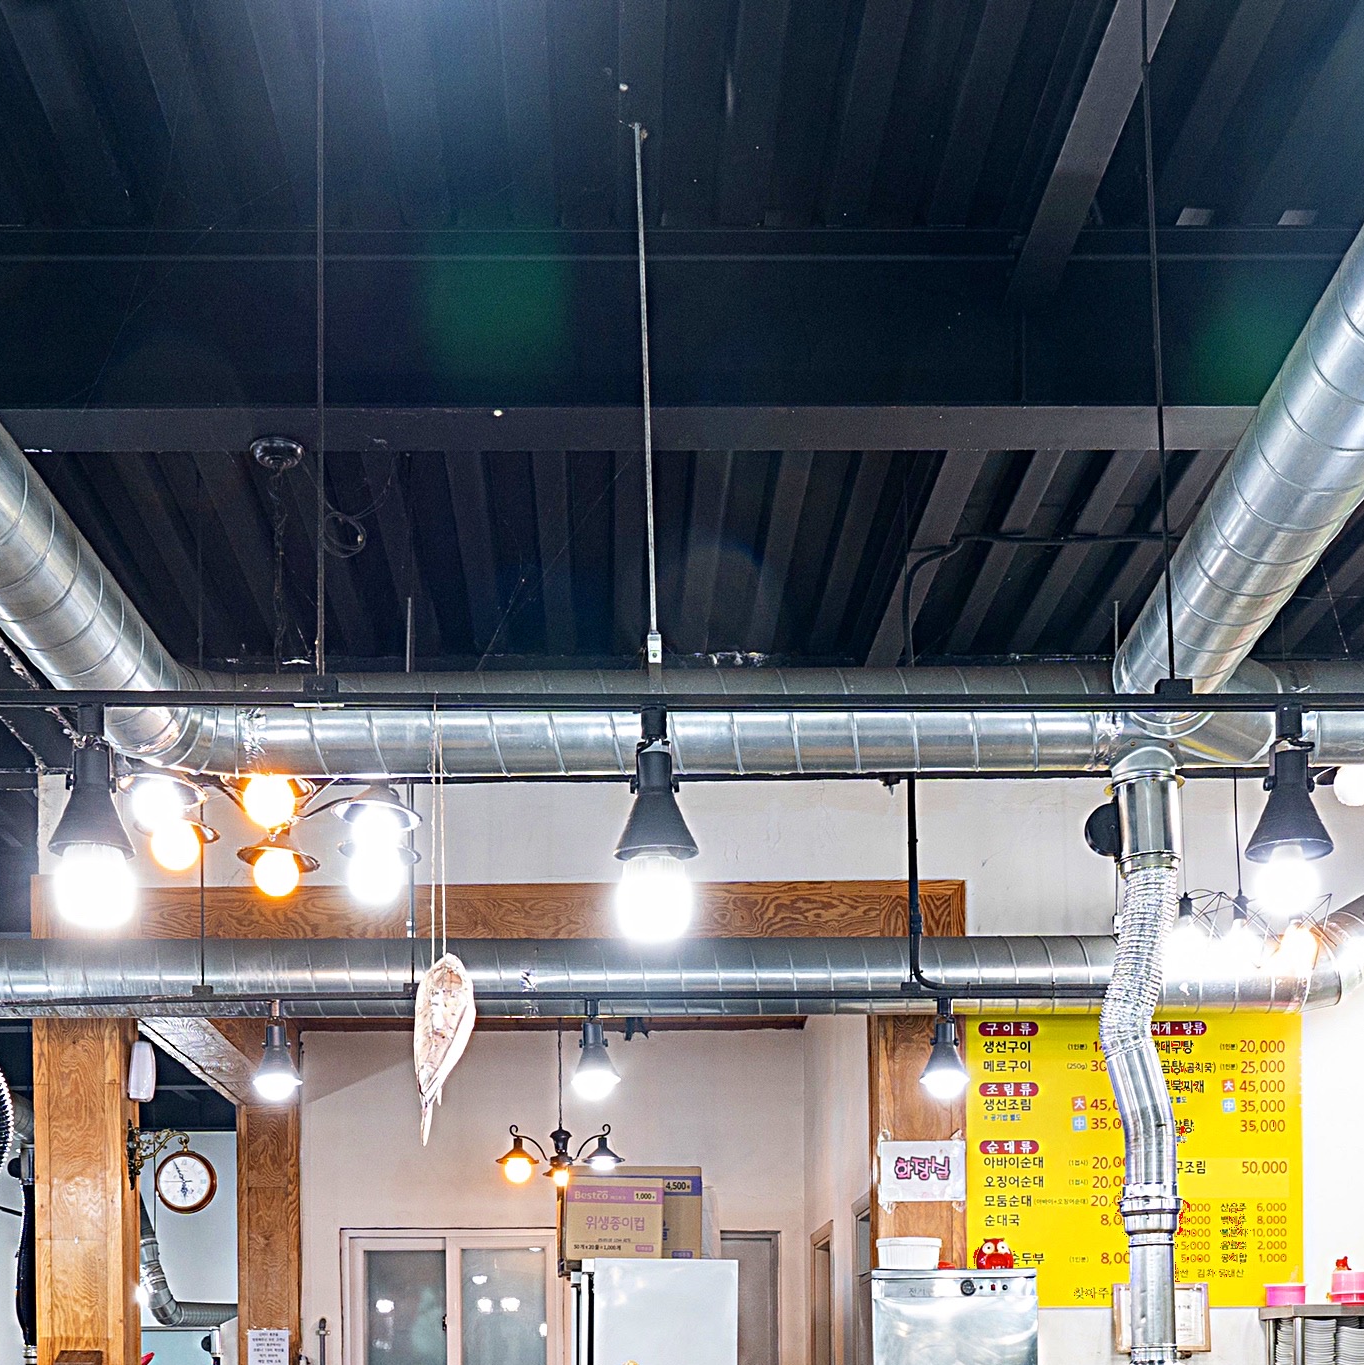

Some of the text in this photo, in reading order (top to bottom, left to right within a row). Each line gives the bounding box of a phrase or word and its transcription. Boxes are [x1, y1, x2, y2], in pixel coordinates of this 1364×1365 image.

[983, 1040, 1032, 1054] 생선구이
[1240, 1039, 1285, 1054] 20,000
[983, 1060, 1032, 1073] 메로구이
[1240, 1060, 1285, 1074] 25,000
[1239, 1079, 1285, 1094] 45,000
[983, 1098, 1032, 1111] 생선조림
[1240, 1099, 1285, 1114] 35,000
[1240, 1120, 1285, 1134] 35,000
[894, 1155, 951, 1180] 화장실
[983, 1157, 1044, 1169] 아바이순대
[1242, 1160, 1288, 1175] 50,000
[665, 1181, 686, 1191] 4,500
[984, 1175, 1044, 1188] 오징어순대
[984, 1195, 1032, 1207] 모둠순대
[1256, 1202, 1287, 1213] 6,000
[585, 1215, 646, 1231] 위생종이컵
[984, 1214, 1020, 1226] 순대국
[1256, 1215, 1287, 1226] 8,000
[1252, 1228, 1287, 1239] 10,000
[1181, 1241, 1211, 1251] 5,000
[1257, 1241, 1287, 1252] 2,000
[1181, 1254, 1211, 1264] 5,000
[1259, 1253, 1287, 1264] 1,000
[1073, 1287, 1112, 1300] 찾아주
